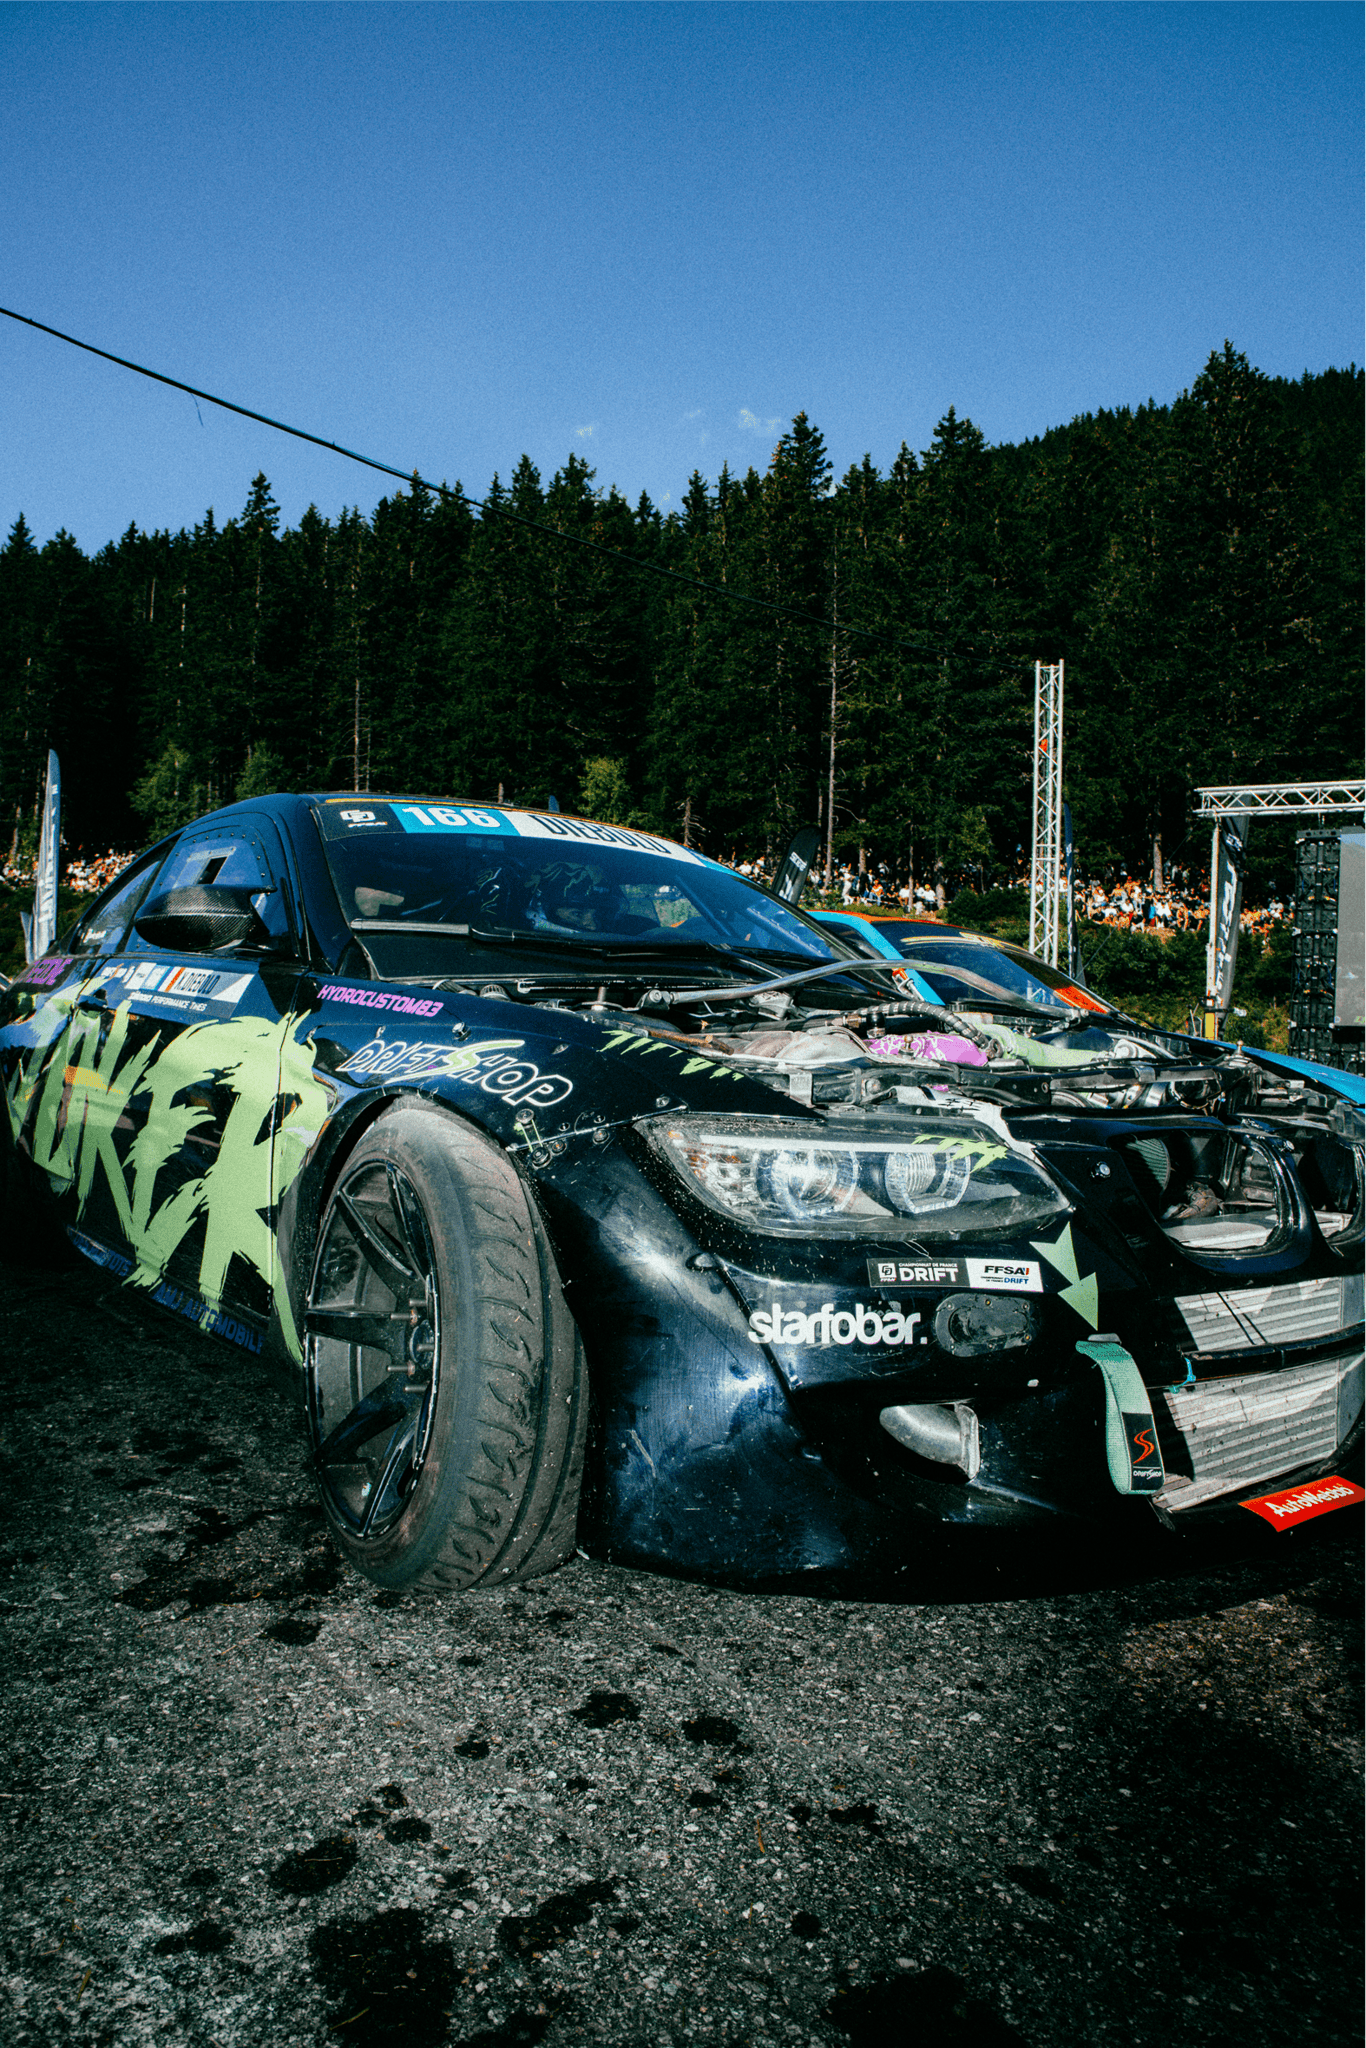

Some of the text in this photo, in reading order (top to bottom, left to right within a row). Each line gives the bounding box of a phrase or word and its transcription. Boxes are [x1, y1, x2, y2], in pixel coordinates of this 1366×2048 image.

[402, 807, 501, 828] 166
[528, 814, 672, 855] DIEBOLD
[316, 984, 444, 1018] HYDROCUSTOM83
[899, 1267, 959, 1282] DRIFT
[984, 1265, 1026, 1276] FFSA
[1004, 1276, 1029, 1285] DRIFT
[747, 1302, 928, 1346] starfobar.
